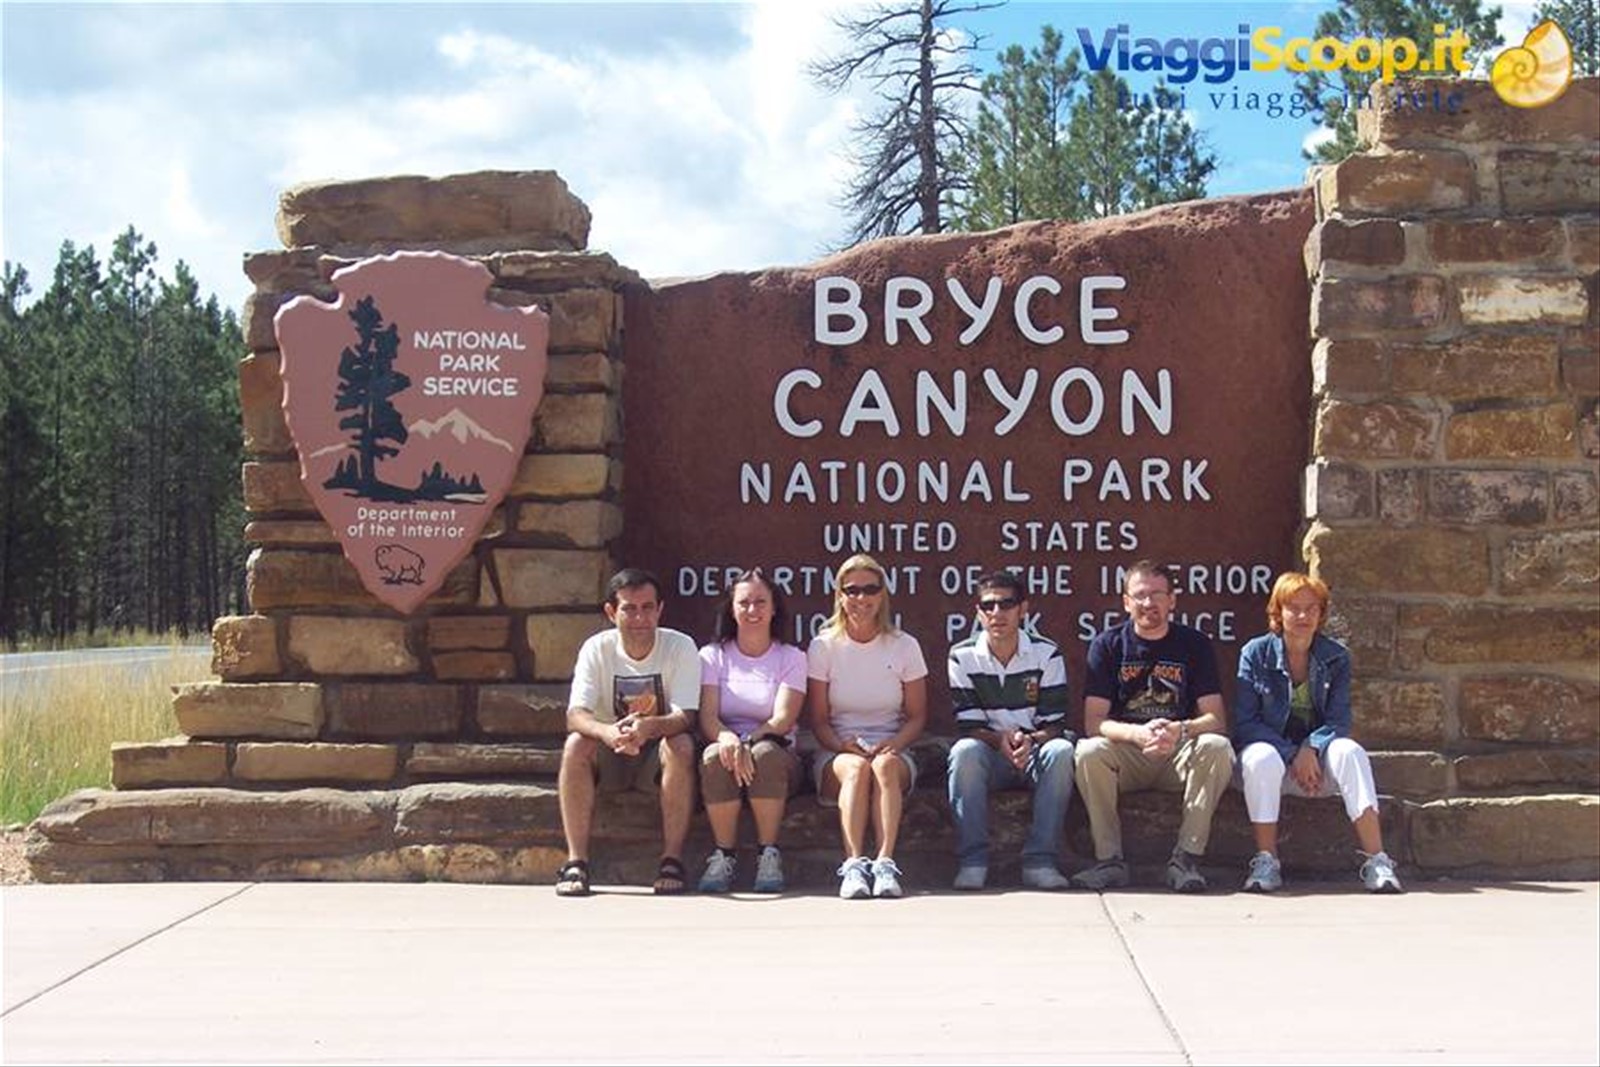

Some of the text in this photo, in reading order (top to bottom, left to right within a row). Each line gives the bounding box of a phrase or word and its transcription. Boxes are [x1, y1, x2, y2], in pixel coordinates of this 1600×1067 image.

[814, 275, 1130, 345] BRYCE
[413, 331, 526, 350] NATIONAL
[439, 354, 501, 372] PARK
[422, 377, 519, 396] SERVICE
[773, 367, 1173, 437] CANYON
[740, 457, 1213, 504] NATIONAL PARK
[357, 506, 457, 523] Department
[347, 524, 365, 538] of
[370, 523, 395, 538] the
[823, 520, 1140, 553] UNITED STATES
[940, 565, 984, 595] OF
[1005, 564, 1073, 595] THE
[1100, 564, 1273, 595] INERIOR
